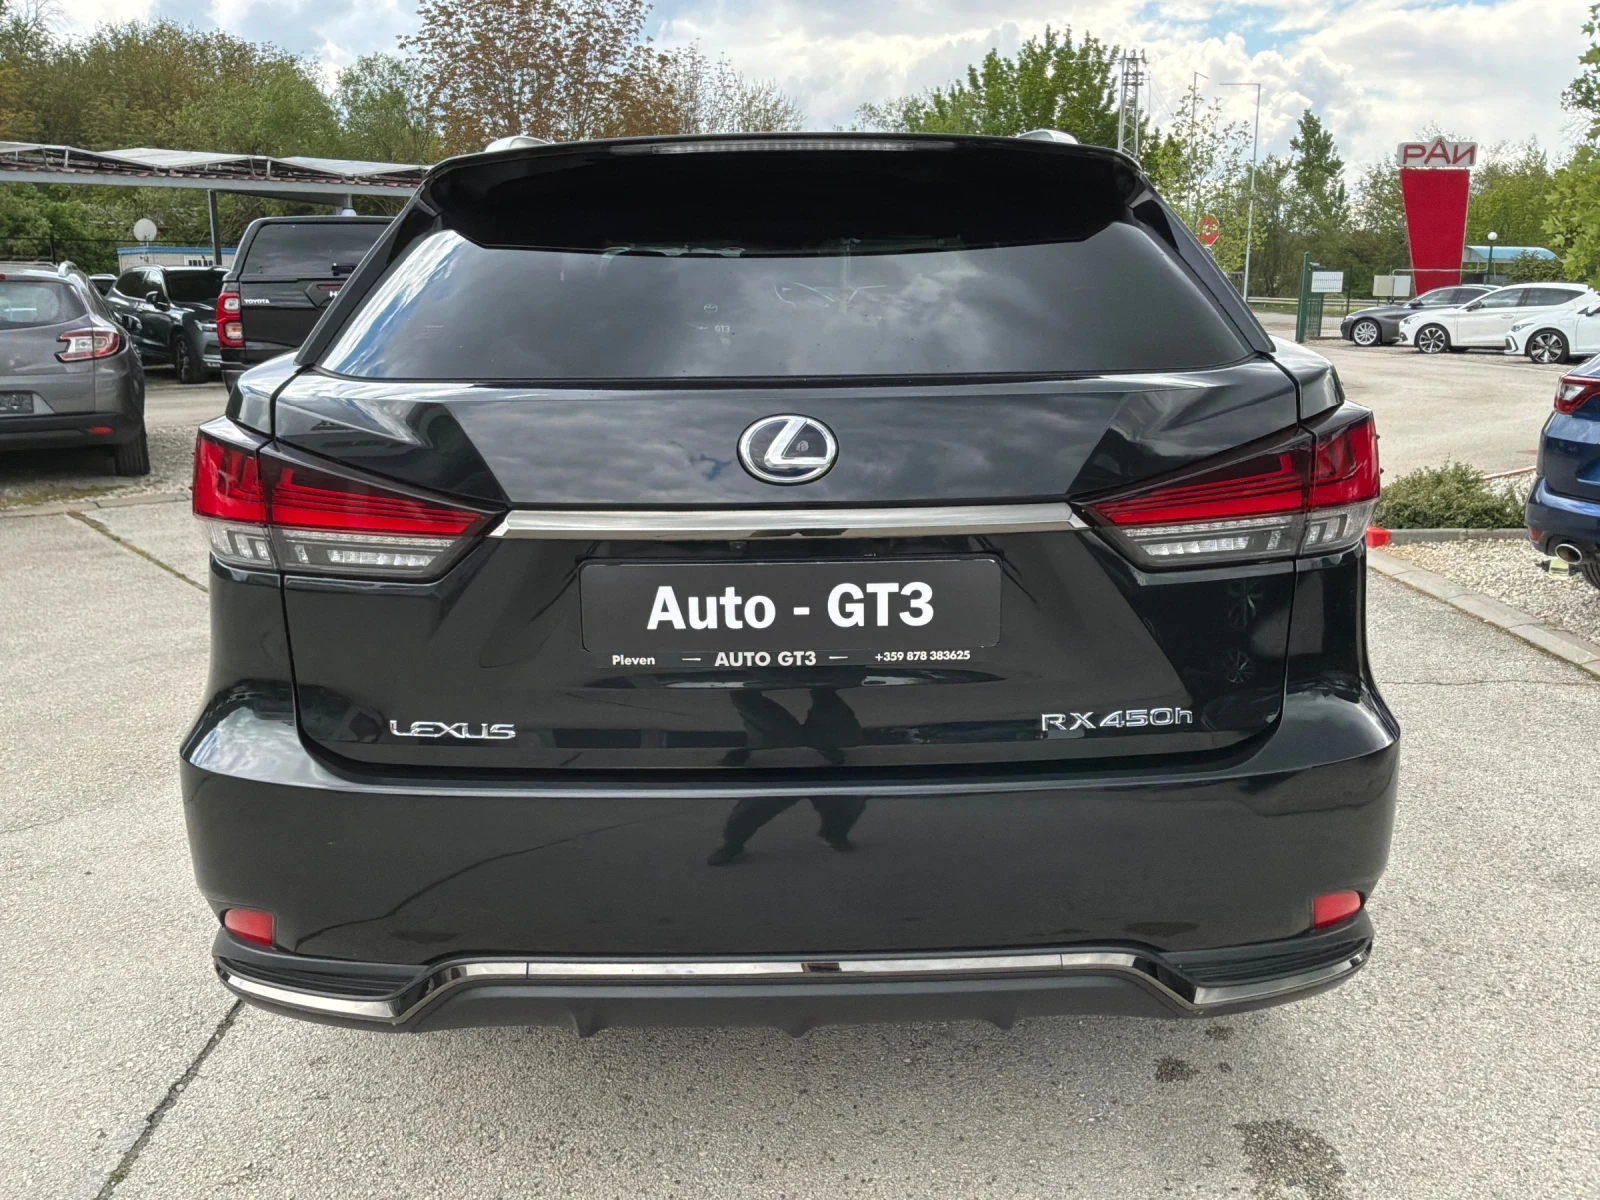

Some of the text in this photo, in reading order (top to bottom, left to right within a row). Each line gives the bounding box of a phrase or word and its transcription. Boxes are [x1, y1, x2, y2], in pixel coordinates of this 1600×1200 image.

[646, 585, 777, 631] Auto
[827, 581, 935, 628] GT3
[611, 654, 656, 666] Pleven
[713, 650, 817, 667] AUTO GT3
[874, 649, 971, 662] +359 878 383625
[1041, 707, 1193, 732] RX 450h
[389, 719, 517, 740] LEXUS
